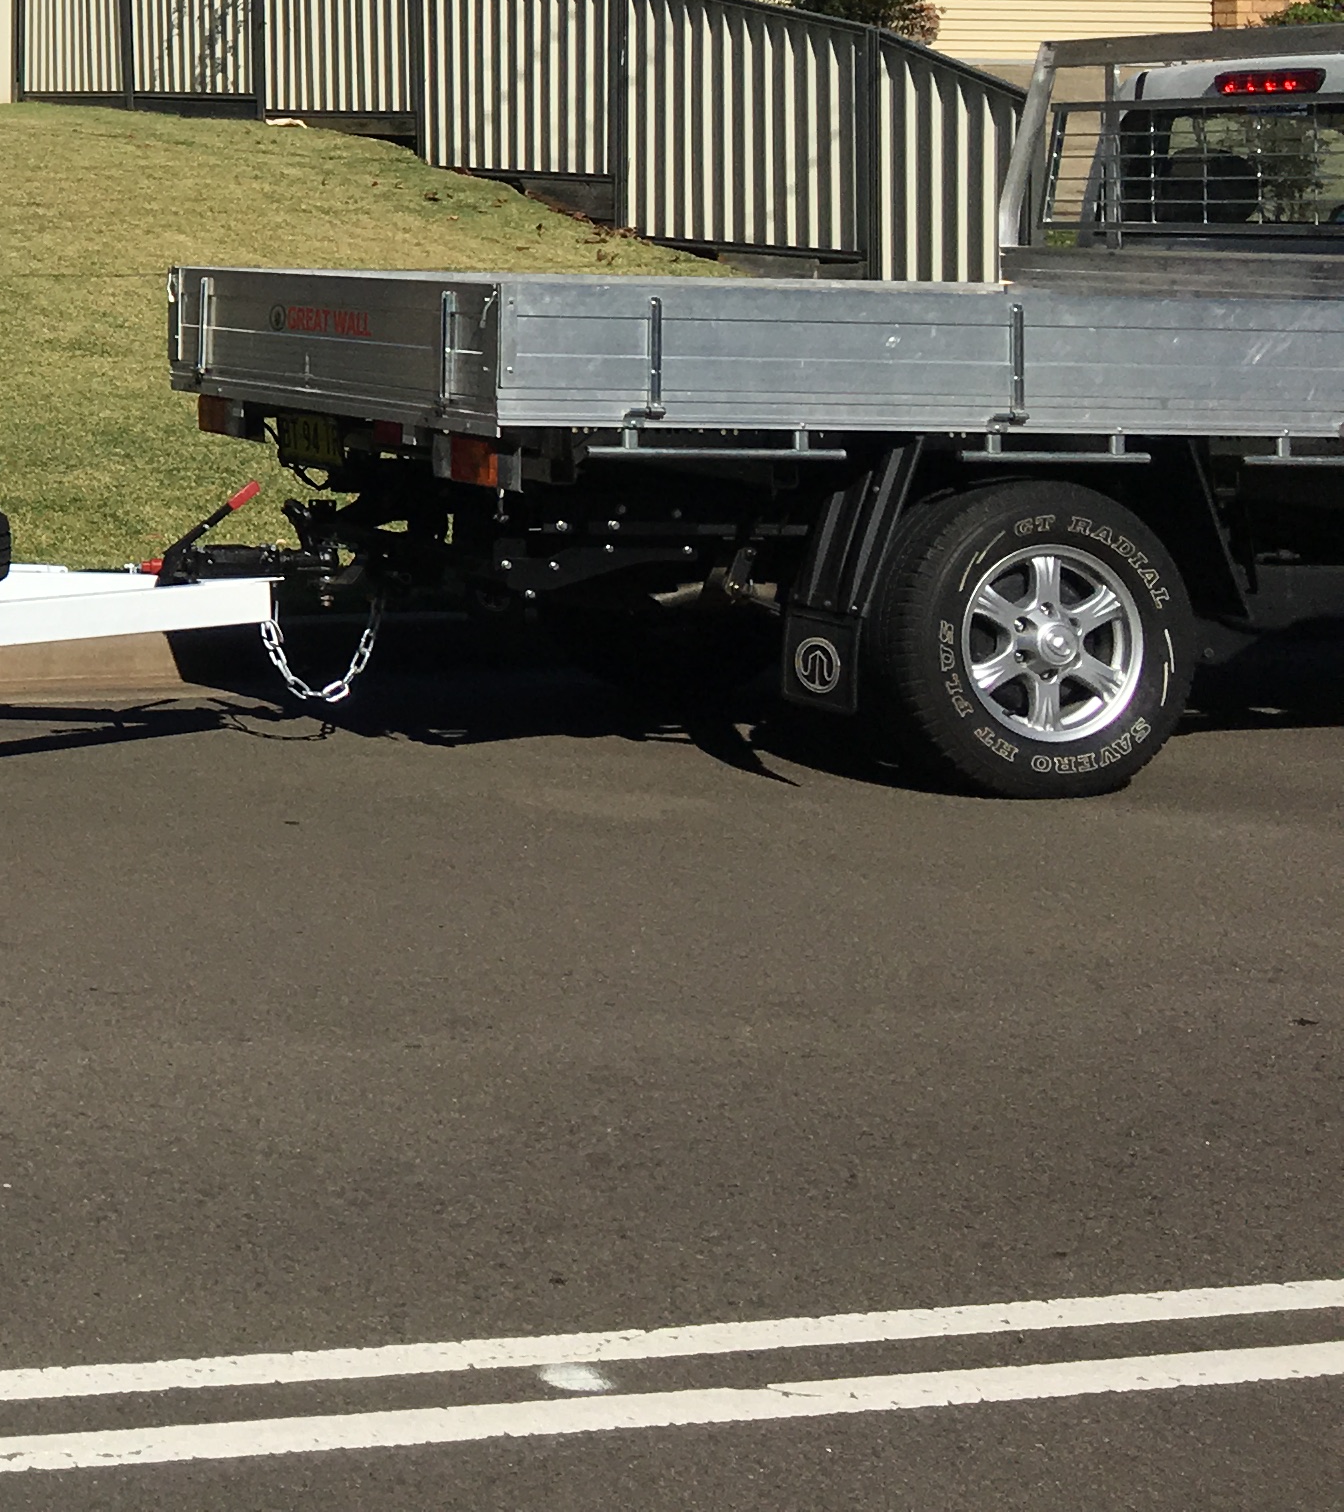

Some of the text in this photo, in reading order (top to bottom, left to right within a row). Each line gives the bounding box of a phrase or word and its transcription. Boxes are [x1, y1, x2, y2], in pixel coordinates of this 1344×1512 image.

[286, 305, 373, 337] GREAT WALL
[1014, 514, 1170, 609] GT RADIAL
[938, 620, 1152, 774] SAVERO HT PLUS
